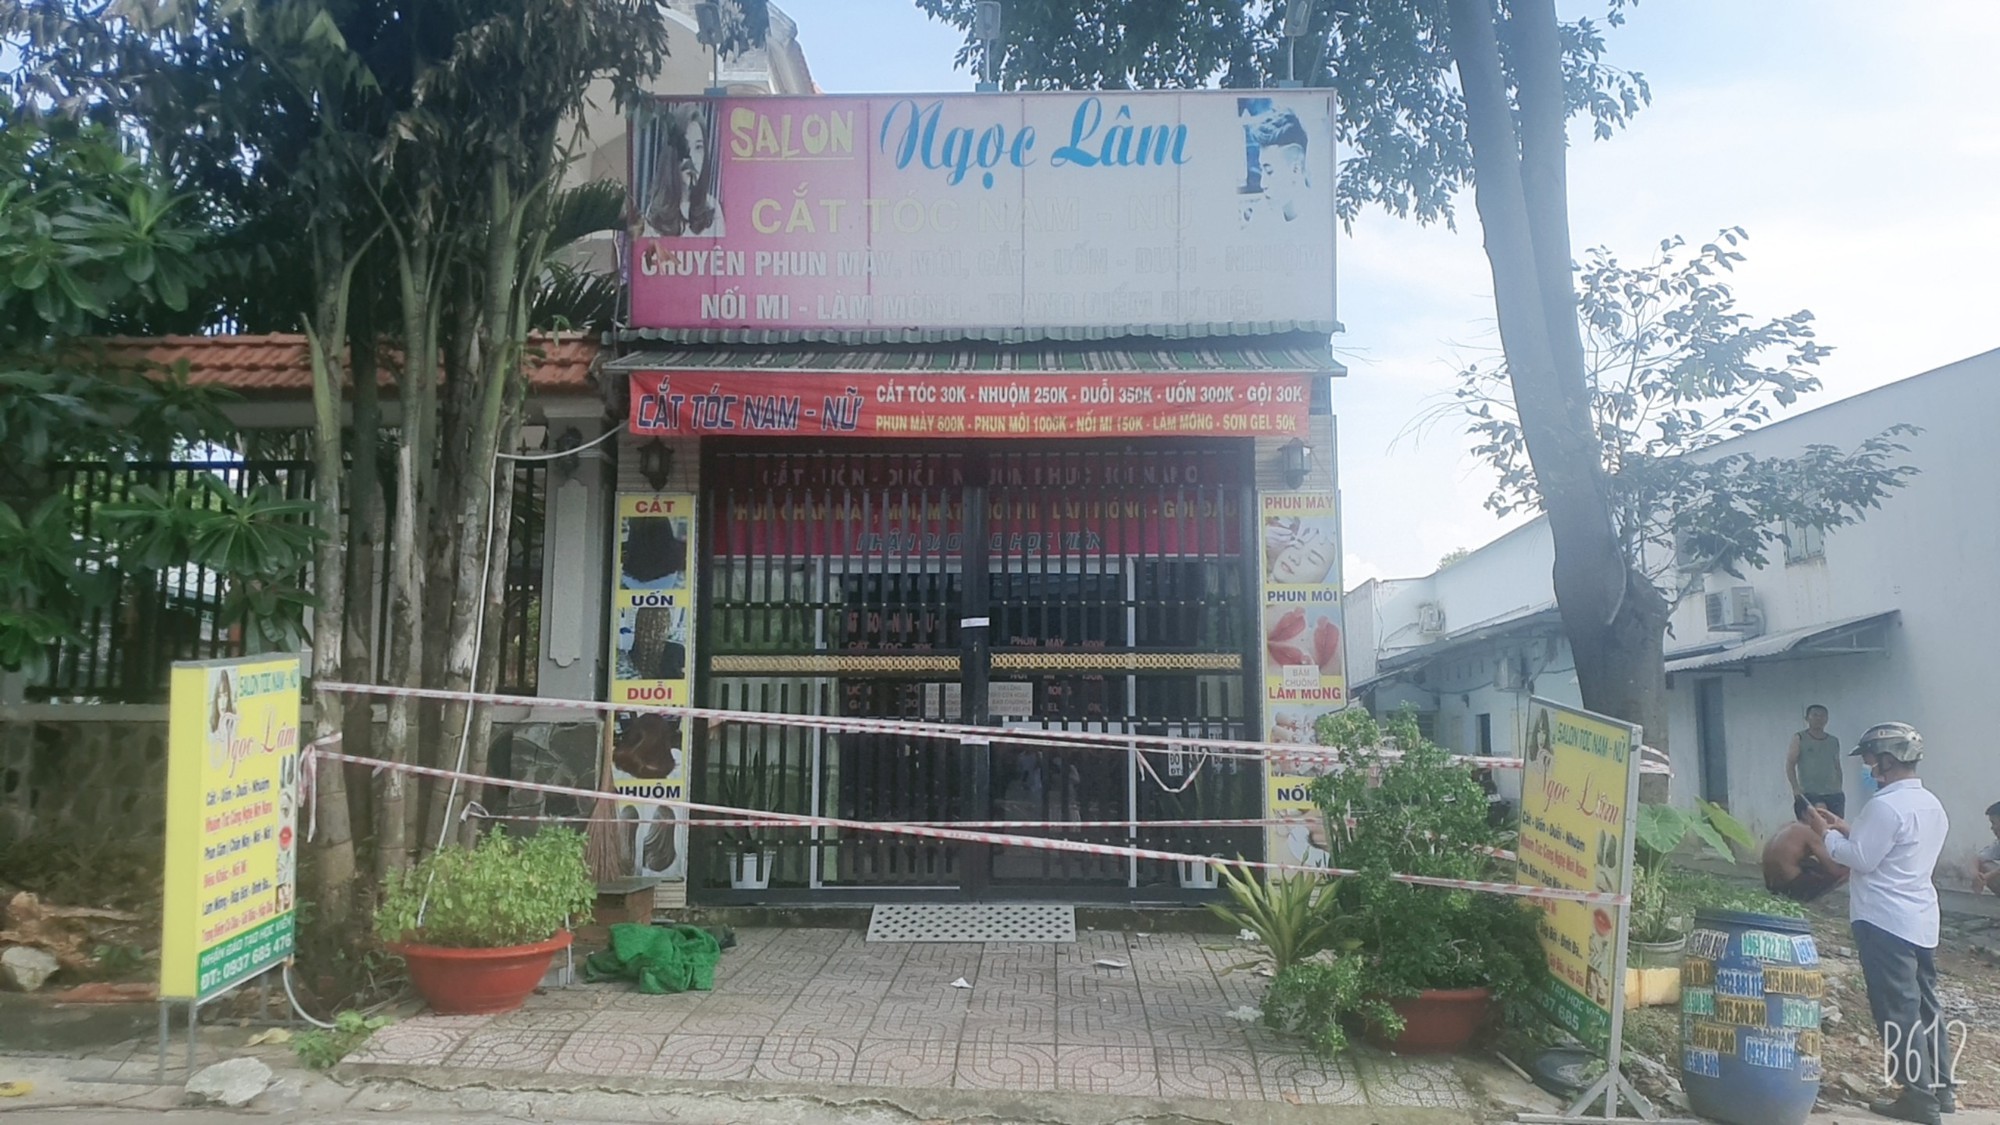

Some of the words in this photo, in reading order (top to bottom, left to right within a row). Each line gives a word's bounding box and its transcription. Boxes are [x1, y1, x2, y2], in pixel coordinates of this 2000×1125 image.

[730, 106, 854, 157] SALON
[880, 99, 1041, 189] Ngọc
[1050, 97, 1192, 168] Lâm
[751, 182, 846, 234] CẮT
[862, 189, 961, 234] TÓC
[977, 197, 1080, 233] NAM
[641, 247, 745, 277] CHUYÊN
[755, 252, 826, 277] PHUN
[977, 241, 1022, 277] CẮT
[701, 285, 746, 320] NỐI
[756, 294, 789, 320] MI
[817, 287, 871, 320] LÀM
[882, 287, 960, 320] MÓNG
[637, 377, 684, 429] CẮT
[690, 383, 738, 429] TÓC
[741, 396, 800, 431] NAM
[821, 387, 864, 431] NỮ
[876, 379, 905, 403] CẮT
[909, 381, 935, 403] TÓC
[940, 386, 966, 403] 30K
[978, 382, 1030, 407] NHUỘM
[1034, 386, 1068, 404] 250K
[1080, 378, 1114, 404] DUỖI
[1118, 386, 1153, 404] 350K
[1165, 379, 1196, 404] UỐN
[1200, 385, 1234, 403] 300K
[1247, 383, 1272, 407] GỘI
[1276, 385, 1303, 402] 30K
[876, 415, 906, 431] PHUN
[910, 411, 934, 432] MÀY
[938, 415, 965, 431] 600K
[974, 415, 1006, 432] PHUN
[1009, 411, 1030, 432] MÔI
[1033, 415, 1067, 432] 1000K
[1076, 410, 1096, 431] NỐI
[1100, 416, 1112, 431] MI
[1153, 411, 1176, 431] LÀM
[1179, 411, 1213, 431] MÓNG
[1251, 415, 1273, 431] GEL
[1276, 415, 1296, 431] 50K
[635, 495, 675, 513] CẮT
[1265, 497, 1302, 510] PHUN
[1306, 494, 1333, 509] MÀY
[631, 590, 674, 606] UỐN
[1267, 590, 1307, 601] PHUN
[1311, 587, 1338, 601] MÔI
[627, 681, 672, 700] DUỖI
[1269, 684, 1297, 699] LÀM
[1558, 1007, 1579, 1031] 685
